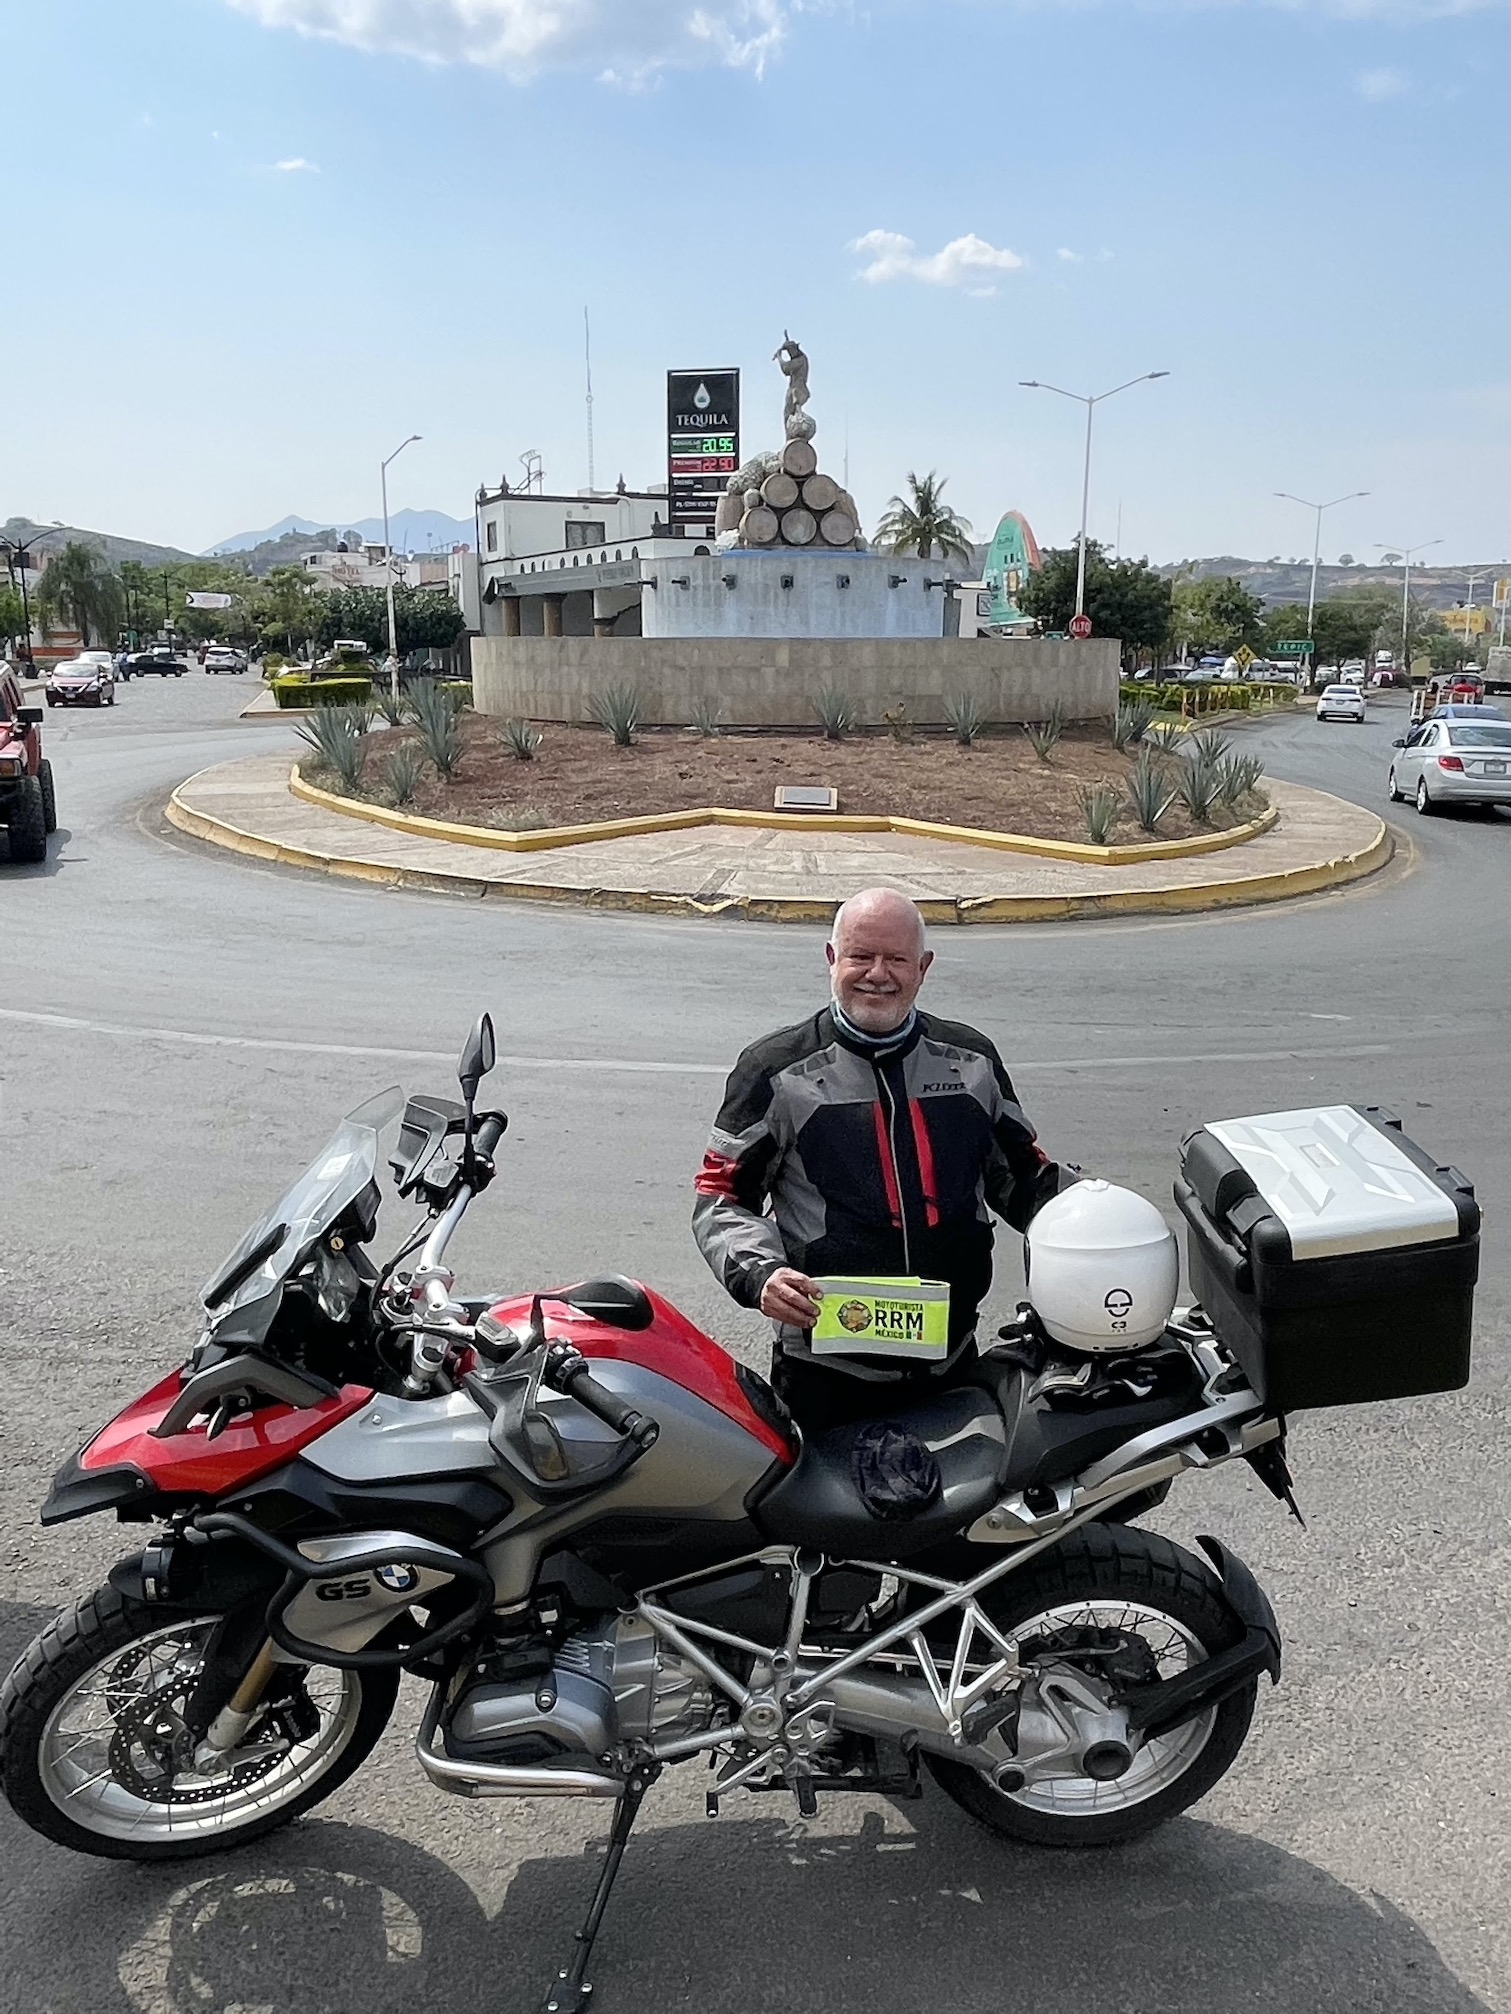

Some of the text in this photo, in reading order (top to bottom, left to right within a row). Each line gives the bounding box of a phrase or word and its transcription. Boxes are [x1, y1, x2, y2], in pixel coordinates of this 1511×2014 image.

[676, 413, 729, 428] TEQUILA
[702, 438, 734, 452] 20.95
[1072, 621, 1090, 632] ALTO
[875, 1299, 923, 1312] MOTOTURISTA
[875, 1309, 923, 1331] RRM
[315, 1579, 371, 1601] GS
